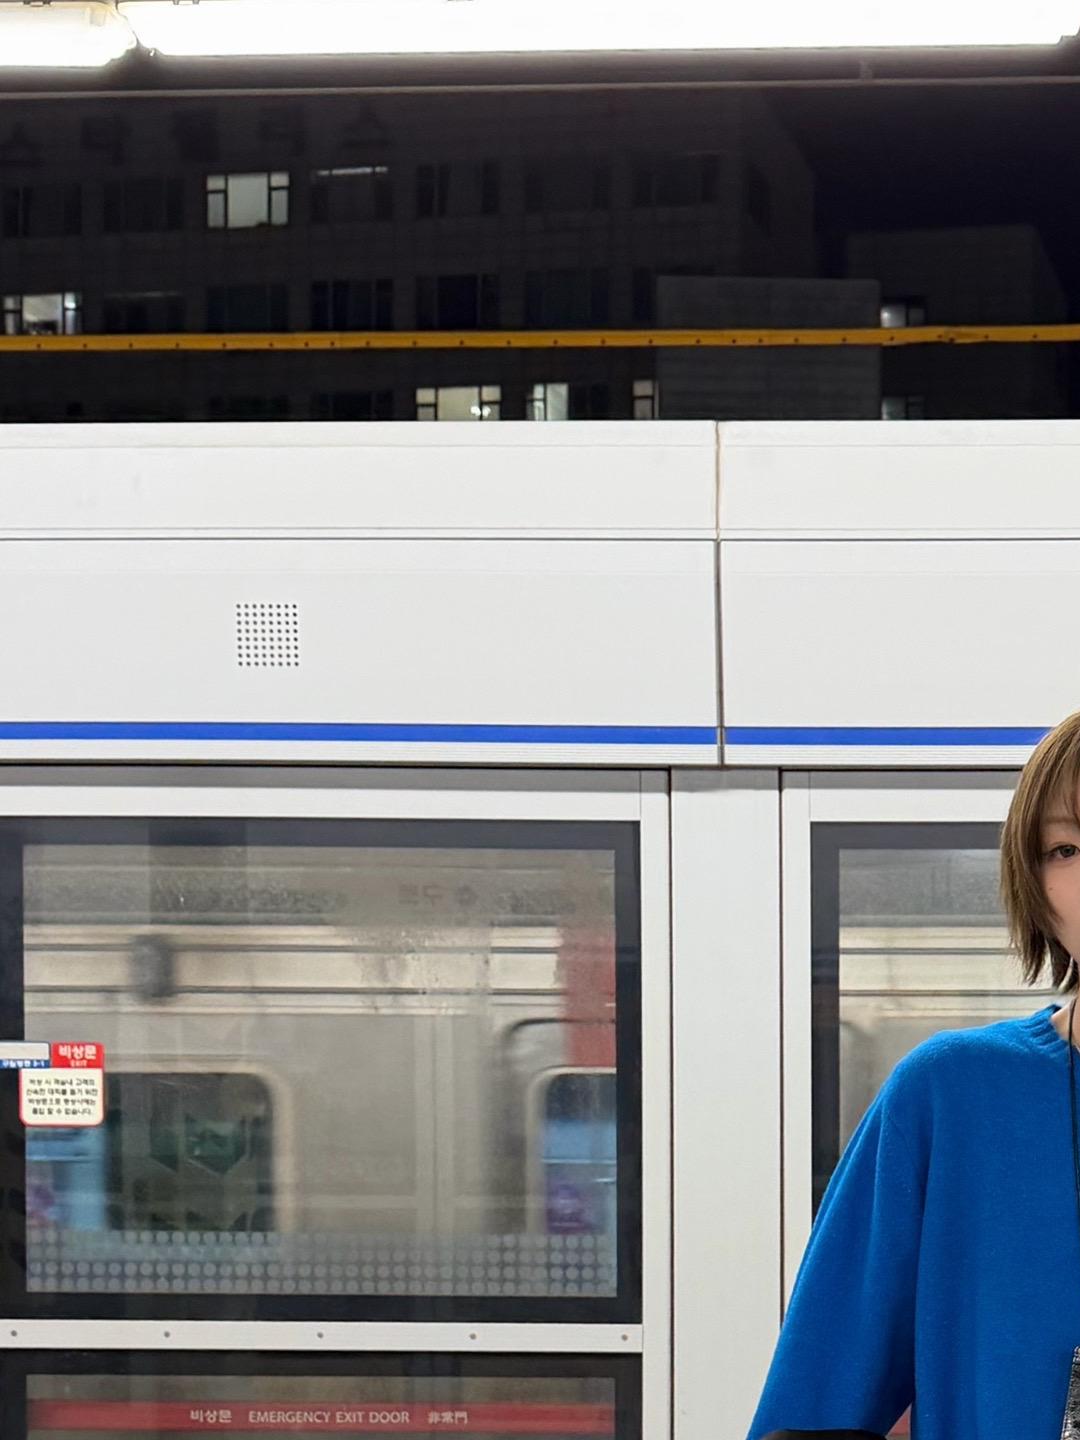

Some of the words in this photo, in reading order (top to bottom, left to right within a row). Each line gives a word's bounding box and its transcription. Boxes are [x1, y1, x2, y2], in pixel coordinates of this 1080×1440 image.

[58, 1044, 97, 1060] 비상문
[190, 1410, 233, 1424] 비상문
[248, 1411, 330, 1424] EMERGENCY
[336, 1411, 364, 1424] EXIT
[369, 1411, 410, 1424] DOOR
